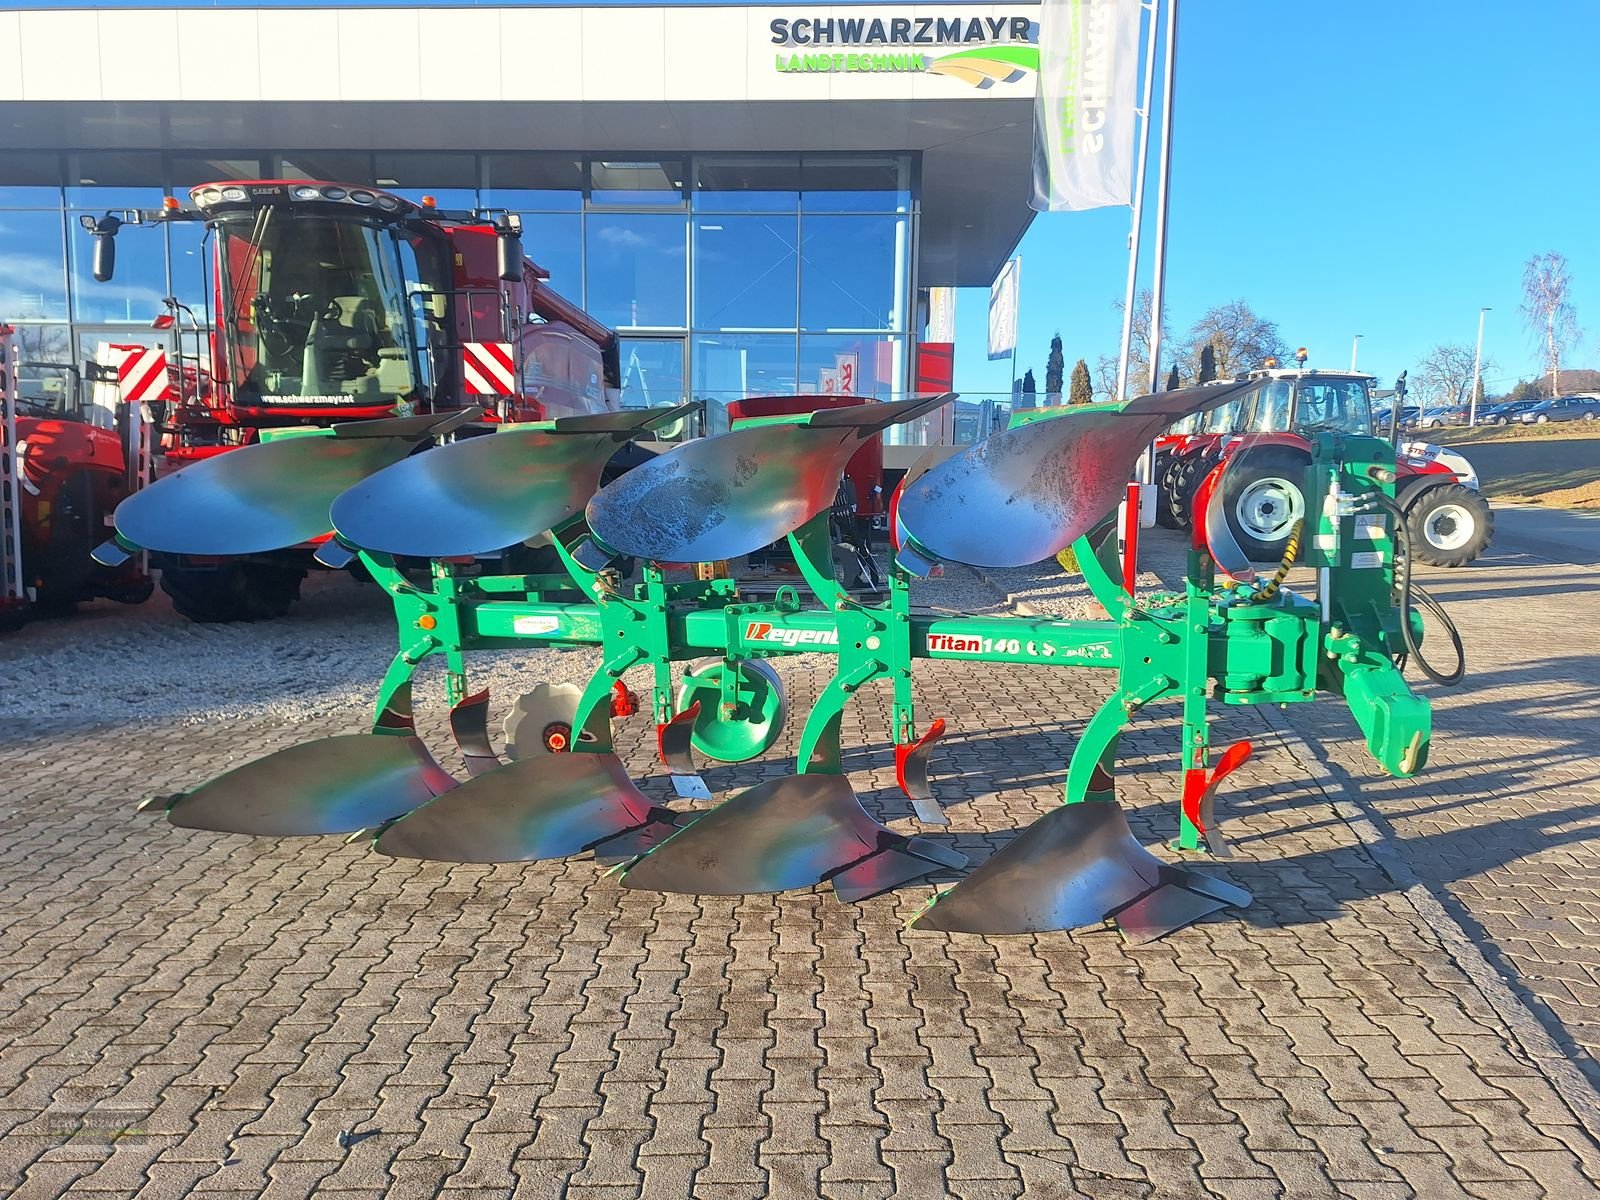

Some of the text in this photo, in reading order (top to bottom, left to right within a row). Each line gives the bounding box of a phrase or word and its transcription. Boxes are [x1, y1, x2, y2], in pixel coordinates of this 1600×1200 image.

[770, 17, 1031, 44] SCHWARZMAYR
[775, 53, 925, 72] LANDTECHNIK
[261, 394, 354, 404] www.schwarzmayr.at
[1408, 447, 1437, 458] STEYR
[927, 635, 980, 651] Titan
[982, 638, 1020, 655] 140
